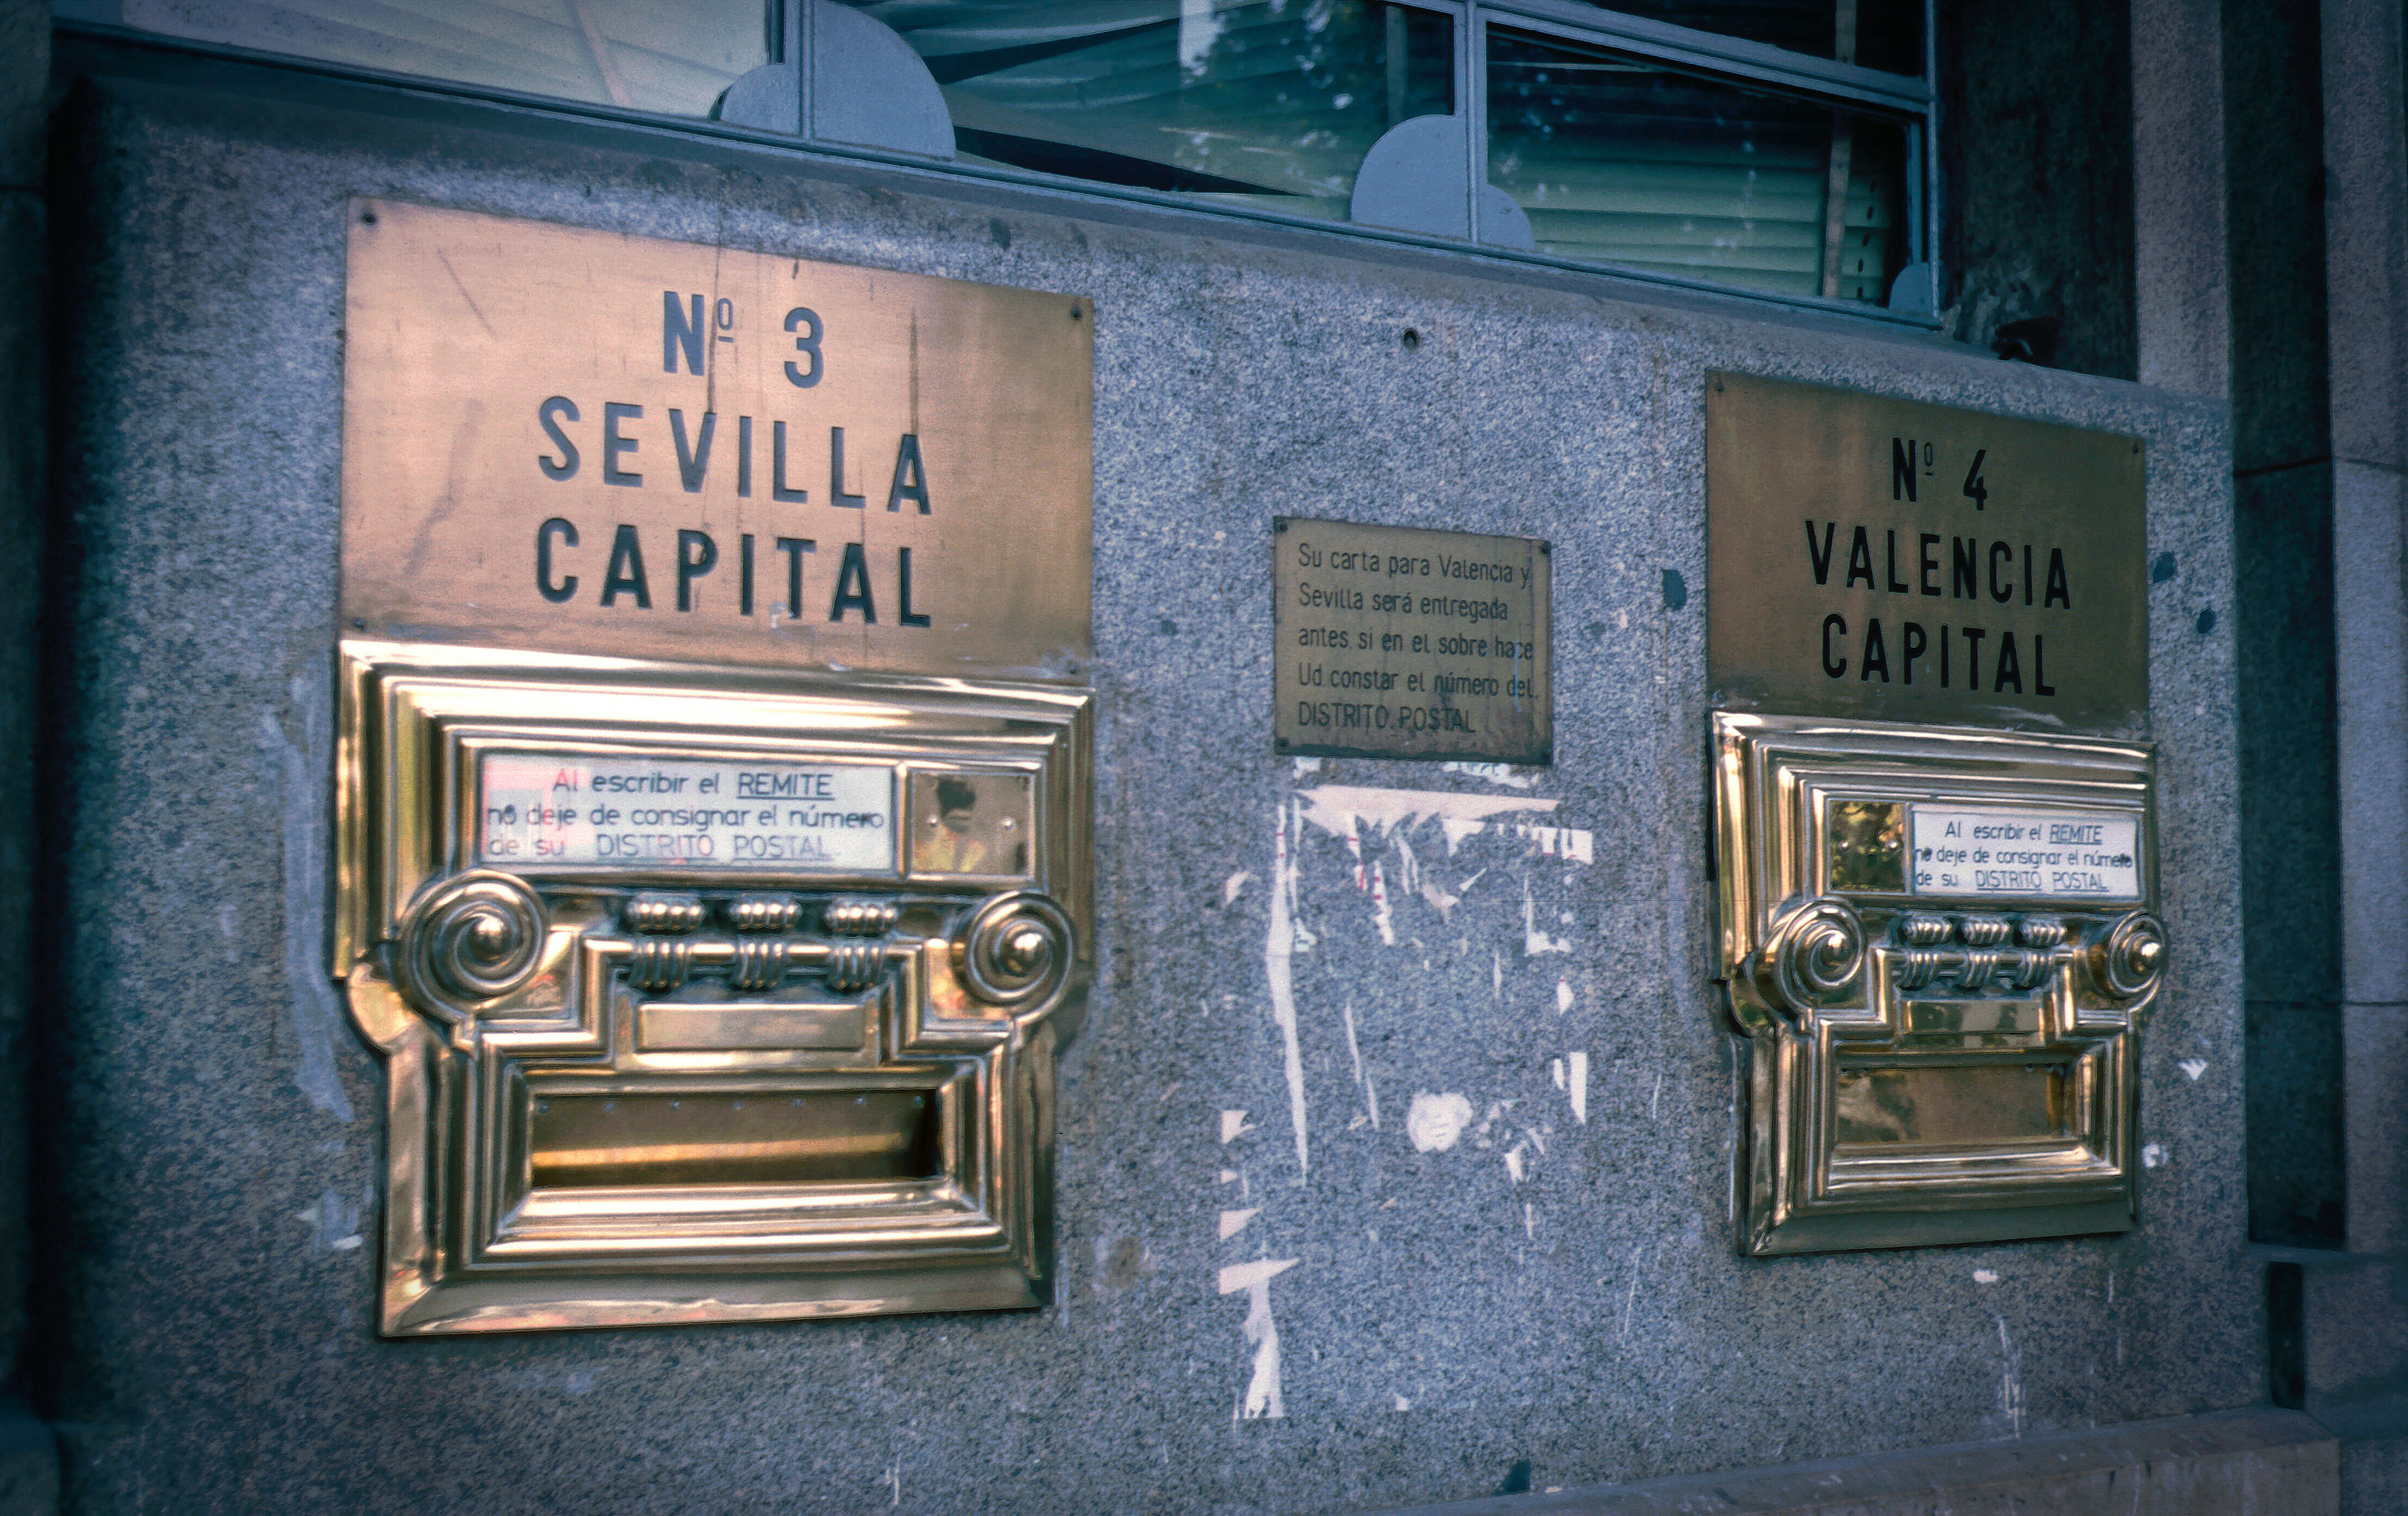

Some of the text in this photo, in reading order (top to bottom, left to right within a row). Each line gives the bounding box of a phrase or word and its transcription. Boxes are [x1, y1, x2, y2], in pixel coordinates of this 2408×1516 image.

[663, 290, 824, 389] Nº 3
[538, 396, 932, 515] SEVILLA
[1892, 437, 1988, 511] Nº 4
[538, 517, 931, 628] CAPITAL
[1299, 543, 1531, 589] Su carta para Valencia y
[1805, 519, 2071, 610] VALENCIA
[1299, 583, 1508, 623] Sevilla será entregada
[1298, 627, 1348, 648] antes
[1358, 627, 1373, 650] si
[1382, 632, 1403, 651] en
[1413, 634, 1430, 653] el
[1438, 633, 1488, 657] sobre
[1821, 613, 2056, 696] CAPITAL
[1298, 662, 1322, 686] Ud
[1330, 669, 1399, 691] constar
[1407, 673, 1425, 692] el
[1434, 672, 1499, 697] número
[1399, 706, 1476, 733] POSTAL
[552, 769, 835, 800] Al escribir el REMITE
[526, 804, 577, 831] deje
[590, 804, 621, 826] de
[631, 804, 750, 832] consignar
[758, 806, 777, 827] el
[790, 804, 884, 829] número
[1945, 821, 2104, 845] Al escribir el REMITE
[489, 834, 834, 863] de su DISTRITO POSTAL
[1937, 846, 1967, 866] deje
[1973, 846, 1990, 863] de
[1997, 850, 2062, 868] consignar
[2068, 851, 2078, 865] el
[1916, 870, 2110, 892] de su DISTRITO POSTAL
